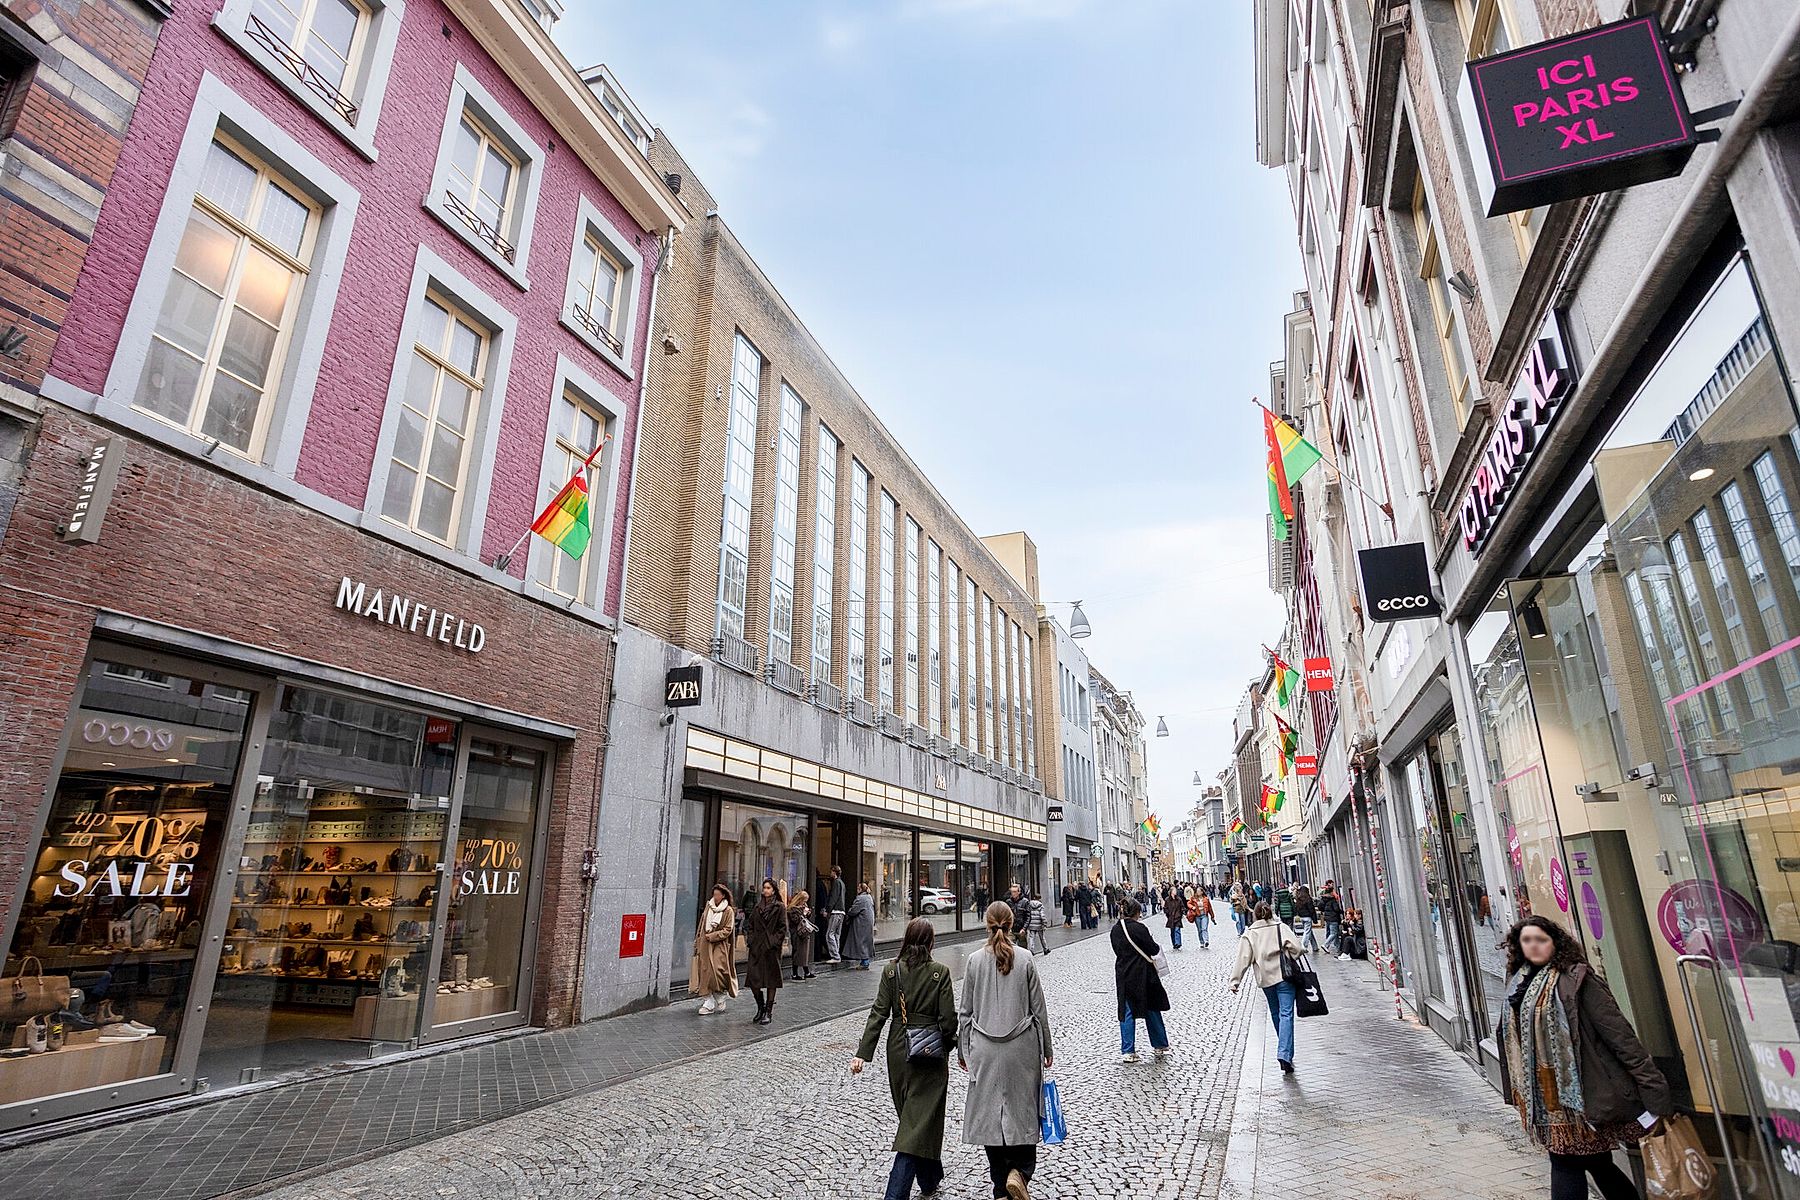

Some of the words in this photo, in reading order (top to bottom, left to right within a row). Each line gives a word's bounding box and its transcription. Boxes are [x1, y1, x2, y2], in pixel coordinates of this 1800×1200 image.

[1537, 54, 1597, 90] ICI
[1513, 76, 1640, 128] PARIS
[1555, 118, 1616, 150] XL
[1458, 489, 1481, 552] ICI
[1476, 399, 1524, 518] PARIS
[1522, 339, 1559, 427] XL
[69, 446, 106, 533] MANFIELD
[335, 576, 486, 653] MANFIELD
[1377, 594, 1429, 612] ecco
[667, 680, 700, 700] ZARA
[1307, 669, 1332, 680] HEM
[1048, 810, 1063, 820] ZARA
[68, 830, 95, 847] to
[74, 811, 108, 833] up
[106, 815, 200, 859] 70%
[464, 850, 475, 863] to
[465, 838, 480, 854] up
[480, 839, 522, 870] 70%
[53, 859, 194, 898] SALE
[460, 870, 521, 896] SALE
[1760, 1072, 1780, 1102] to
